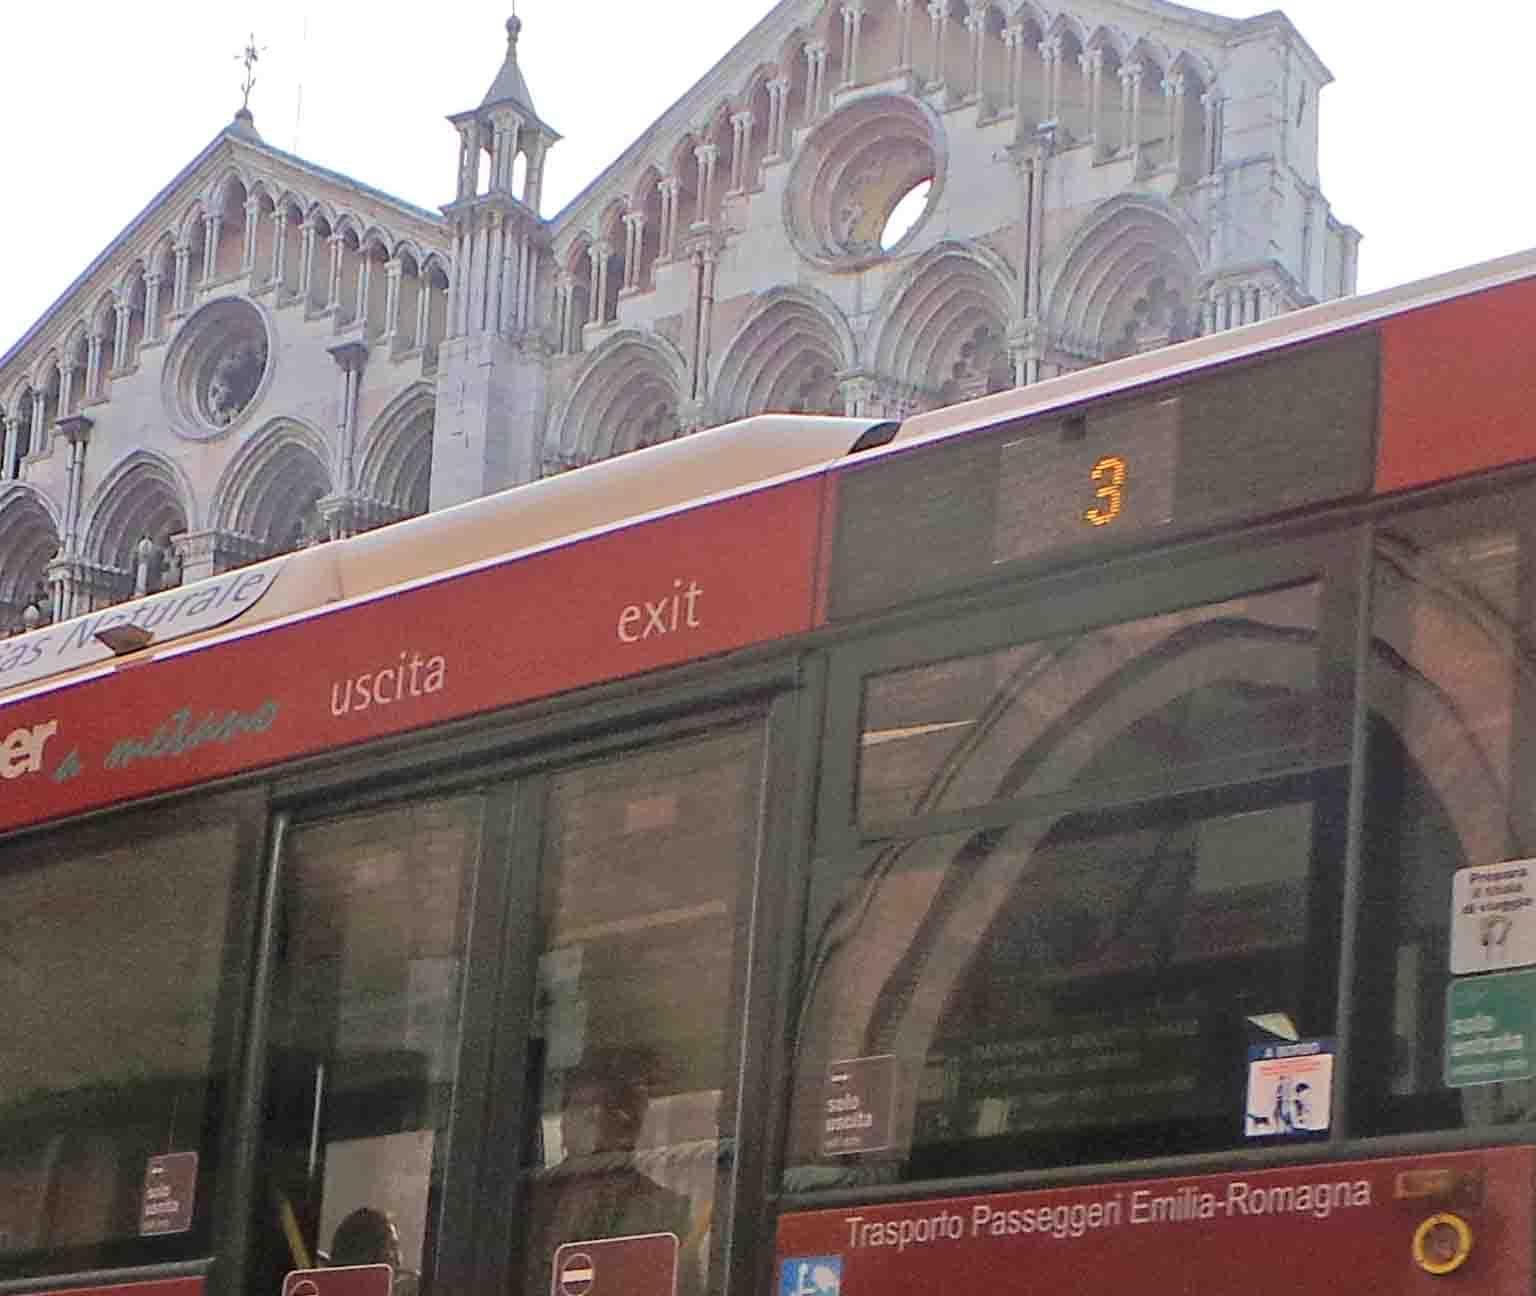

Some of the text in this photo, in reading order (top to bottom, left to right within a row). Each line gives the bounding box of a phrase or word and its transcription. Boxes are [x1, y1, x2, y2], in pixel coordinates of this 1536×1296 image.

[1081, 454, 1129, 528] 3
[58, 569, 266, 656] Nturale
[616, 579, 704, 643] exit
[329, 647, 448, 717] uscita
[844, 1179, 1371, 1251] Trasporto Passeggeri Emilia-Romagna
